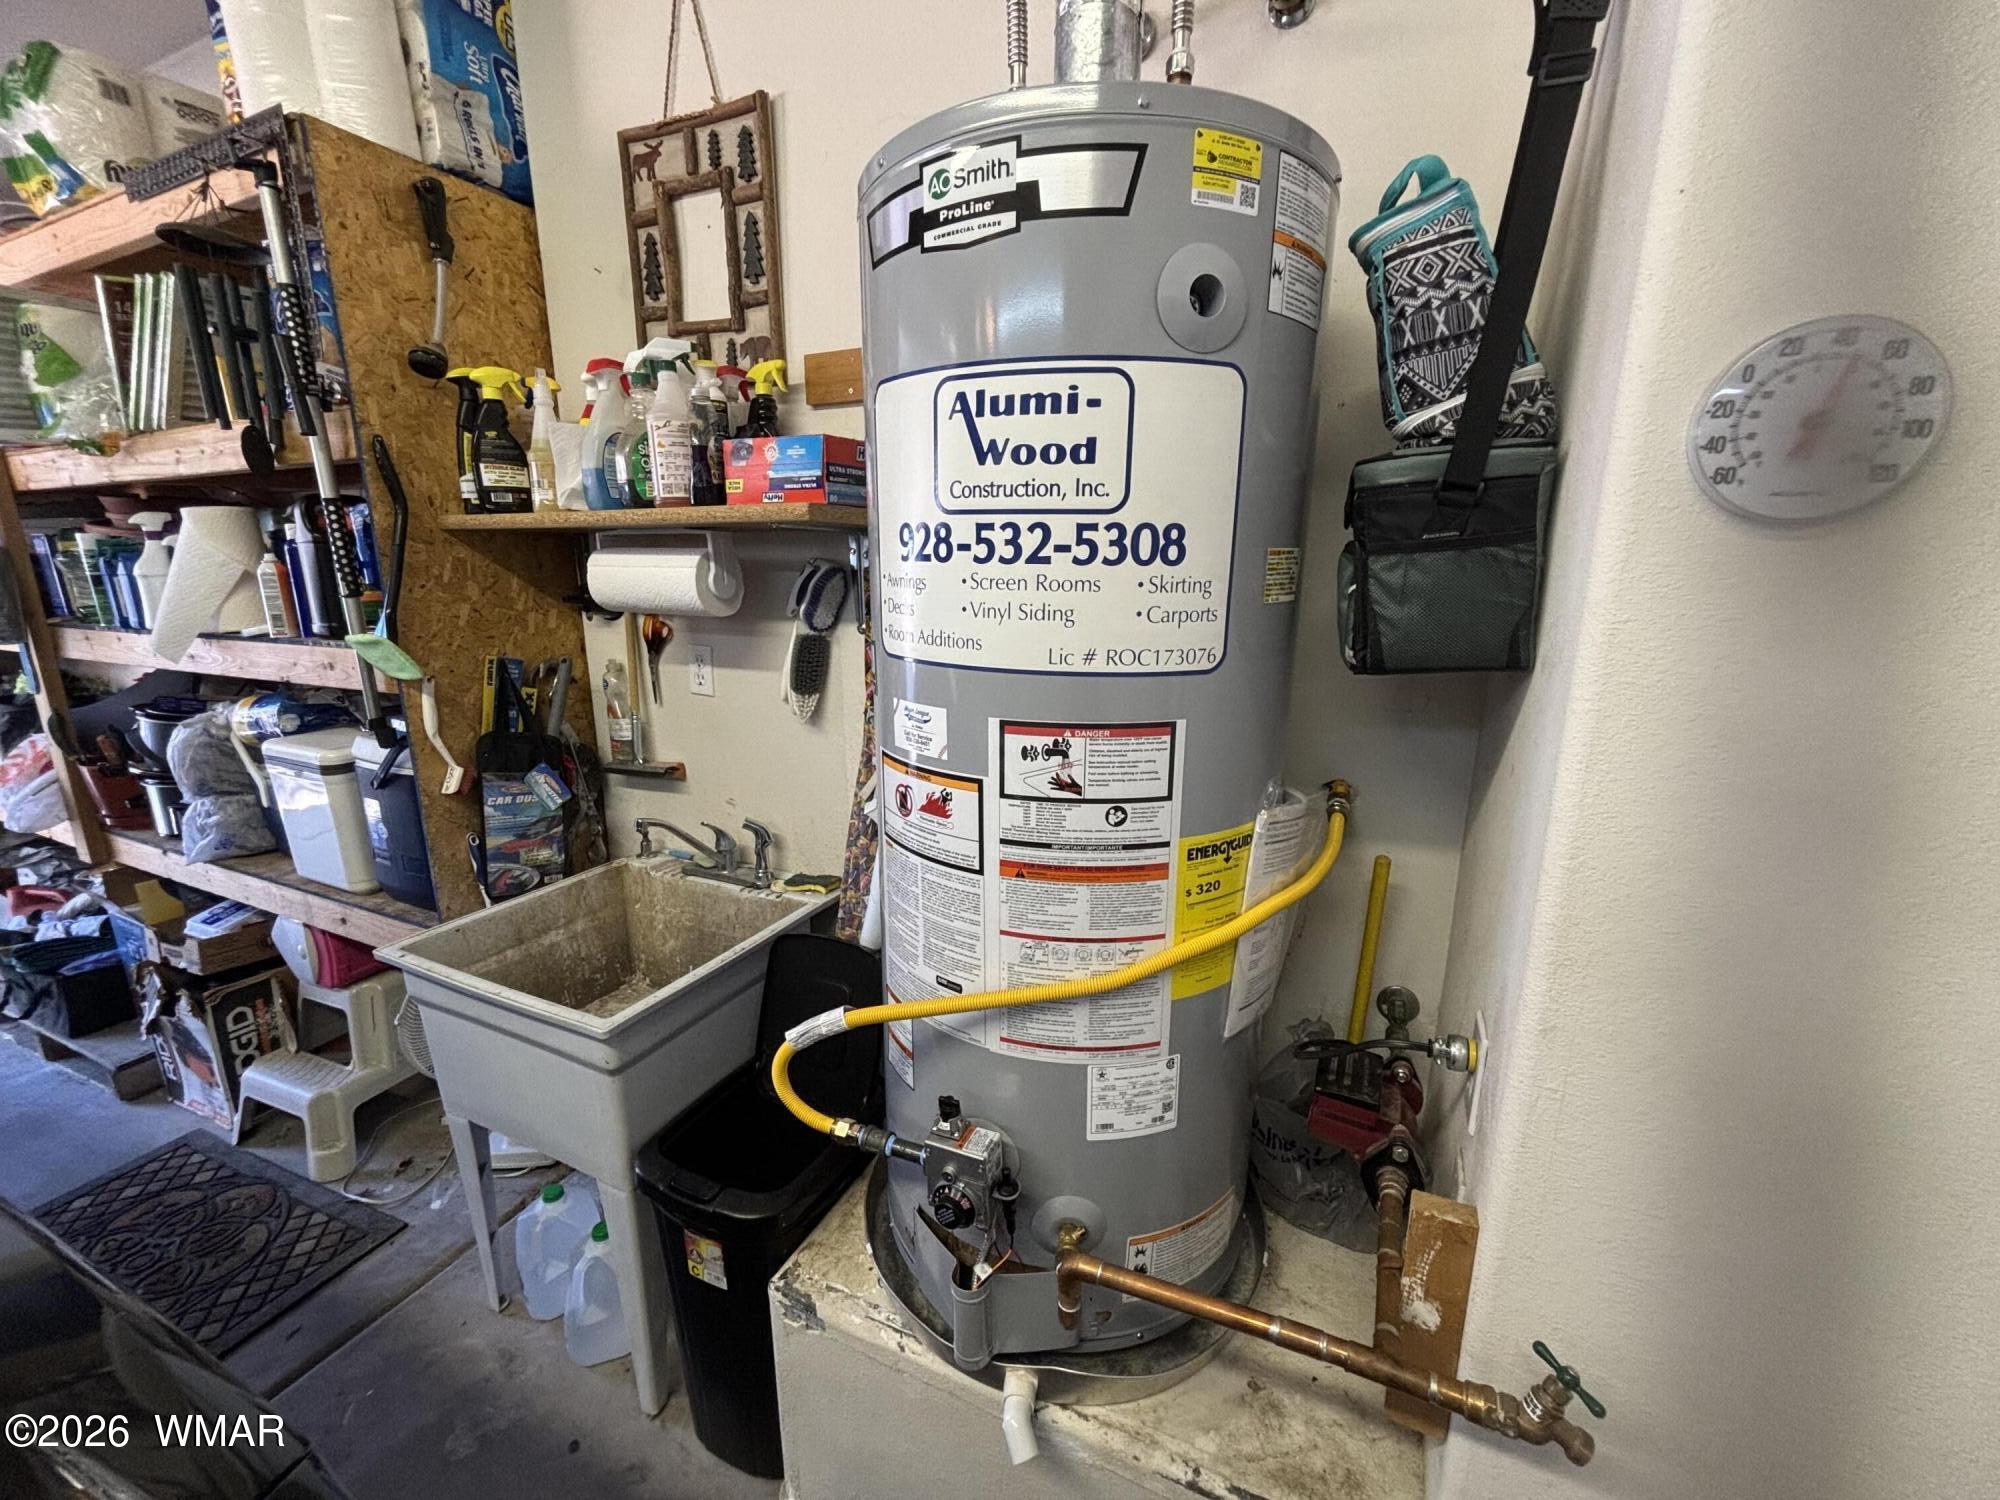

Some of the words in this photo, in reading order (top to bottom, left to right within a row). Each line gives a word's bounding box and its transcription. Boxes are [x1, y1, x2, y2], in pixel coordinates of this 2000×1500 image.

[463, 41, 484, 85] Soft
[953, 157, 1011, 189] Smith
[939, 200, 992, 223] ProLine
[933, 225, 975, 241] COMMERCIAL
[977, 220, 1002, 230] GRADE
[1742, 364, 1755, 383] 0
[1908, 376, 1936, 396] 80
[948, 384, 1102, 421] Alumi-
[1705, 400, 1736, 419] -20
[974, 436, 1097, 466] Wood
[1700, 435, 1727, 454] -40
[1709, 466, 1737, 485] -60
[763, 492, 783, 502] Hefty
[949, 478, 1067, 501] Construction,
[1075, 477, 1110, 497] Inc.
[899, 521, 1187, 566] 928-532-5308
[886, 572, 927, 596] Awnings
[970, 572, 1028, 591] Screen
[1036, 573, 1102, 593] Rooms
[1148, 574, 1213, 600] Skirting
[887, 597, 915, 617] Decs
[970, 601, 1012, 626] Vinyl
[1018, 602, 1075, 629] Siding
[1146, 605, 1219, 629] Carports
[917, 628, 983, 651] Additions
[1048, 647, 1075, 666] Lic
[1082, 647, 1098, 667] #
[1106, 647, 1217, 667] ROC173076
[1074, 730, 1111, 738] DANGER
[487, 795, 512, 806] CAR
[1185, 889, 1192, 897] $
[1196, 879, 1221, 896] 320
